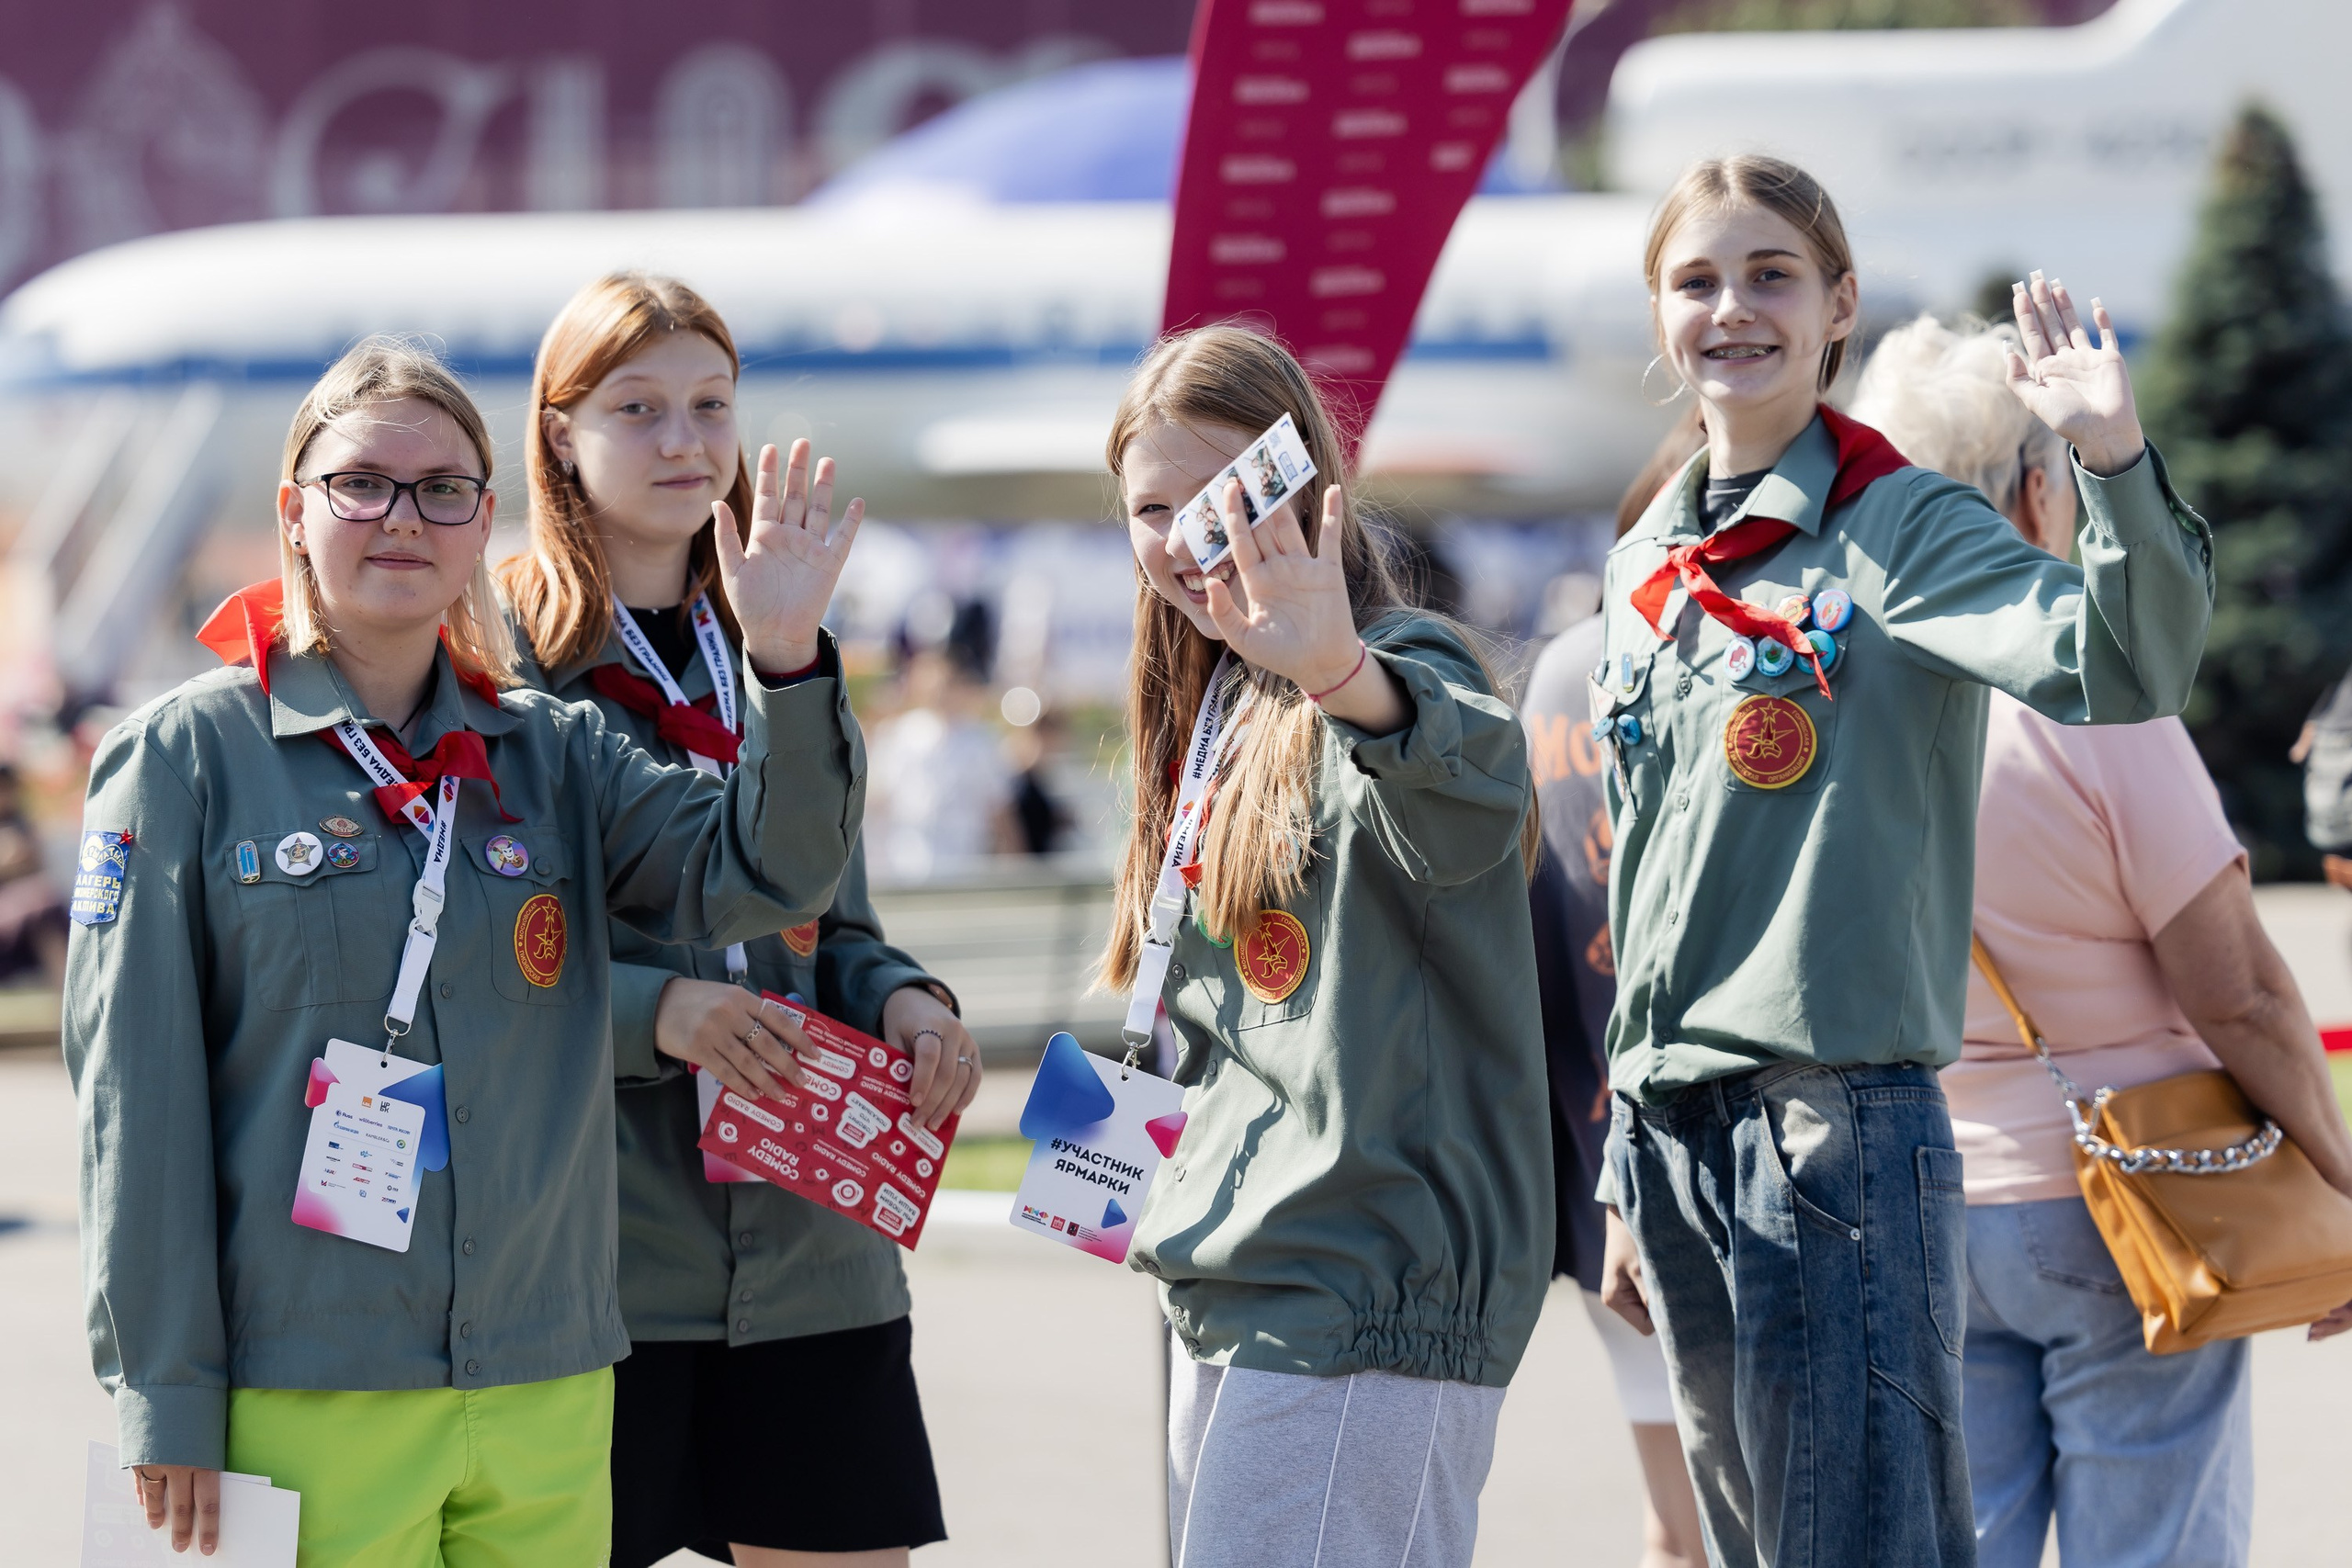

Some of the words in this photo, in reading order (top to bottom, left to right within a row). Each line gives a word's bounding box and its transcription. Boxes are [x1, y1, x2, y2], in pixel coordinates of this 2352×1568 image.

[626, 629, 641, 647] БЕЗ
[718, 668, 729, 688] БЕЗ
[722, 690, 735, 732] МЕДИА
[341, 720, 357, 739] ГРА
[354, 738, 371, 759] БЕЗ
[1193, 736, 1210, 779] #МЕДИА
[369, 755, 398, 787] ЕДИА
[433, 819, 447, 863] #МЕДИА
[75, 874, 121, 889] ЛАГЕРЬ
[518, 902, 537, 941] МОСКОВСКАЯ
[1281, 917, 1305, 947] ГОРОДСКАЯ
[806, 1075, 838, 1096] COME
[728, 1096, 750, 1111] RADIO
[752, 1109, 782, 1129] COMEDY
[747, 1145, 799, 1180] COMEDY
[760, 1138, 799, 1167] RADIO
[812, 1144, 837, 1160] RADIO
[872, 1152, 898, 1175] RADIO
[1050, 1137, 1145, 1181] #УЧАСТНИК
[836, 1156, 866, 1178] COMEDY
[1054, 1158, 1131, 1195] ЯРМАРКИ
[896, 1171, 926, 1198] COMEDY
